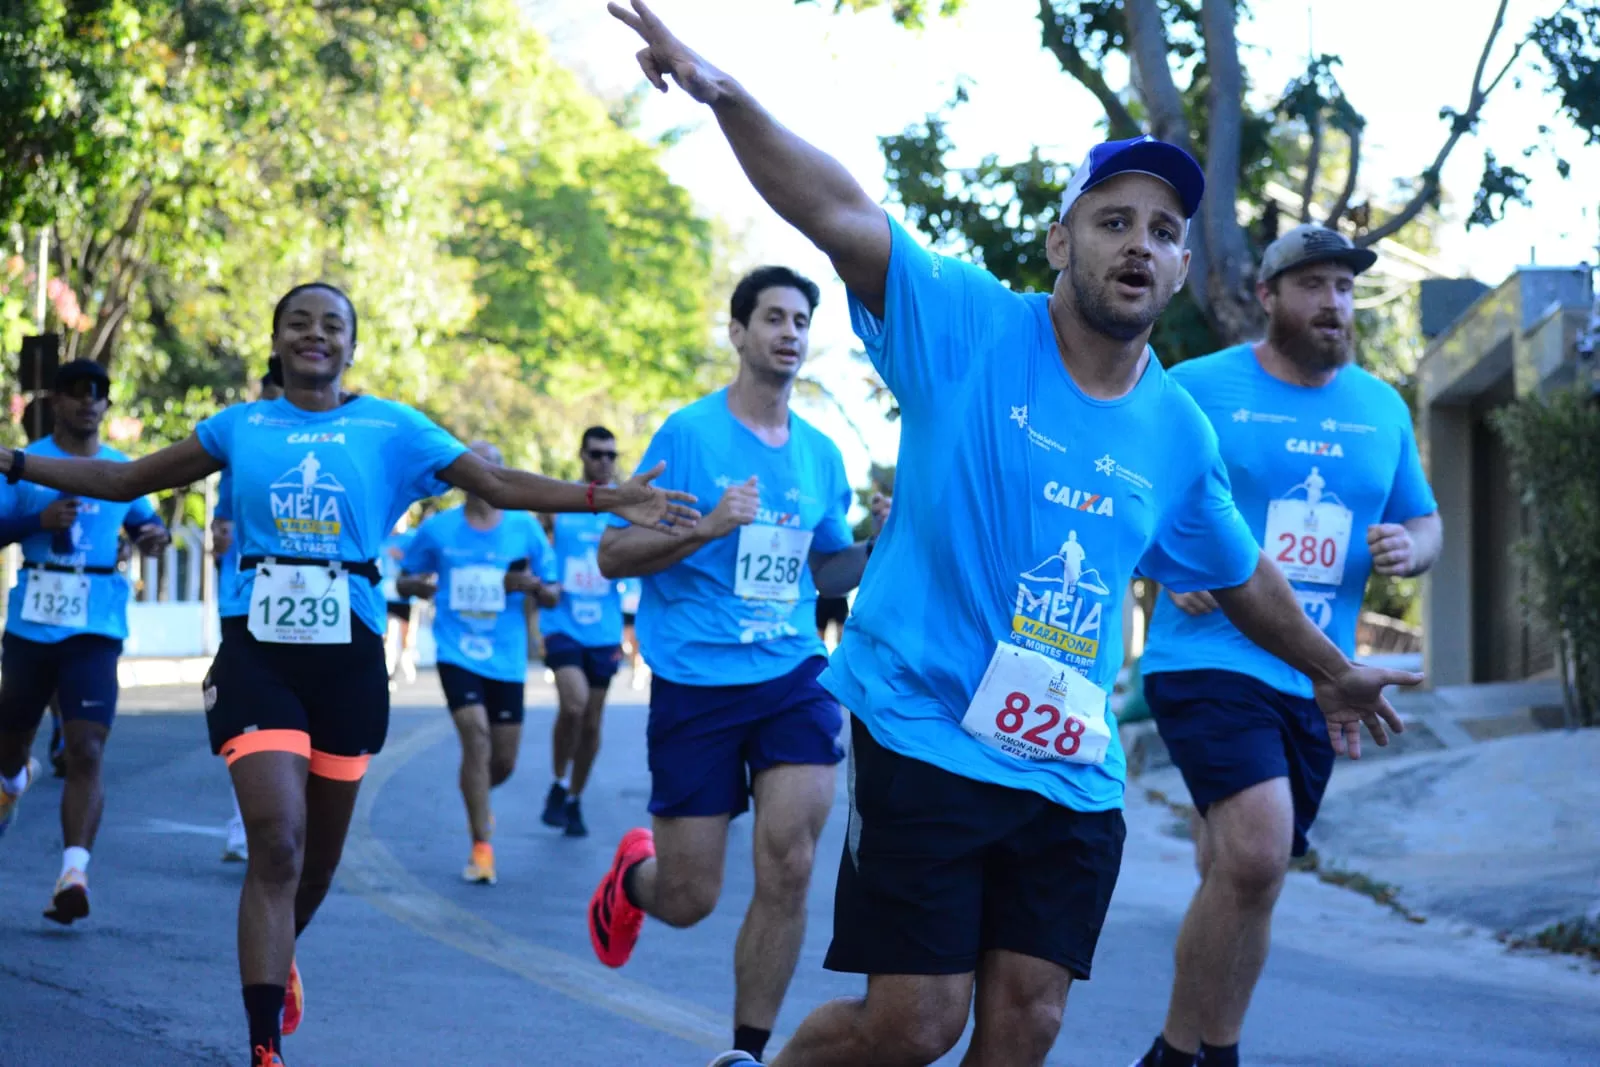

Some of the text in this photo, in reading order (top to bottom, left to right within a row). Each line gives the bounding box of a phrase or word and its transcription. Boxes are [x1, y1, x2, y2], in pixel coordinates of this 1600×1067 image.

[287, 432, 346, 445] CAIXA
[1285, 438, 1344, 458] CAIXA
[270, 492, 341, 522] MEIA
[1043, 481, 1114, 517] CAIXA
[1276, 532, 1336, 568] 280
[740, 553, 800, 584] 1258
[32, 591, 82, 616] 1325
[258, 595, 340, 627] 1239
[1015, 582, 1103, 641] MEIA
[1021, 621, 1094, 655] MARATONA
[1025, 639, 1062, 658] MONTES
[995, 691, 1086, 756] 828
[993, 731, 1027, 750] RAMON
